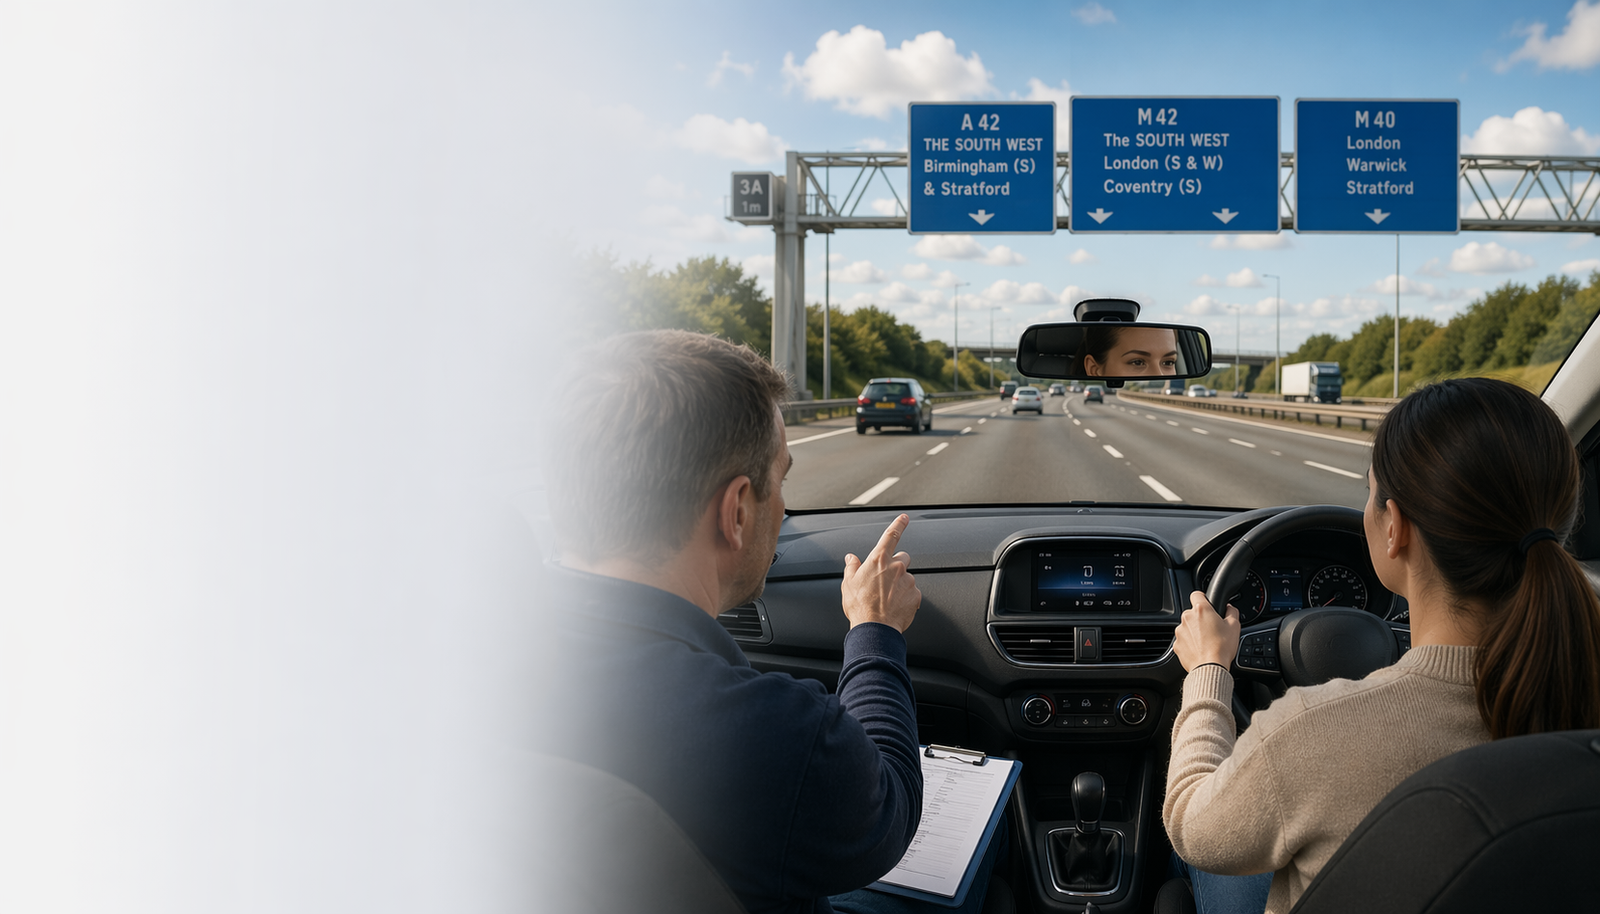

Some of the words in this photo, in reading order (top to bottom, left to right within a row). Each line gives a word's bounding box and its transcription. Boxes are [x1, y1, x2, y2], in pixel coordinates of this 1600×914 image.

[961, 113, 974, 131] A
[978, 113, 1000, 131] 42
[1138, 107, 1152, 126] M
[1155, 108, 1178, 126] 42
[1355, 110, 1369, 128] M
[1373, 111, 1395, 128] 40
[923, 137, 950, 152] THE
[955, 137, 1001, 152] SOUTH
[1006, 137, 1043, 151] WEST
[1103, 133, 1130, 147] The
[1135, 132, 1185, 147] SOUTH
[1190, 133, 1230, 147] WEST
[1347, 135, 1401, 150] London
[924, 158, 1008, 176] Birmingham
[1013, 157, 1036, 175] (S)
[1104, 155, 1159, 170] London
[1164, 154, 1181, 171] (S
[1186, 155, 1198, 170] &
[1202, 154, 1223, 171] W)
[1346, 157, 1407, 172] Warwick
[740, 179, 762, 195] 3A
[923, 181, 935, 196] &
[941, 181, 1010, 196] Stratford
[1103, 178, 1173, 197] Coventry
[1179, 178, 1202, 195] (S)
[1346, 180, 1414, 195] Stratford
